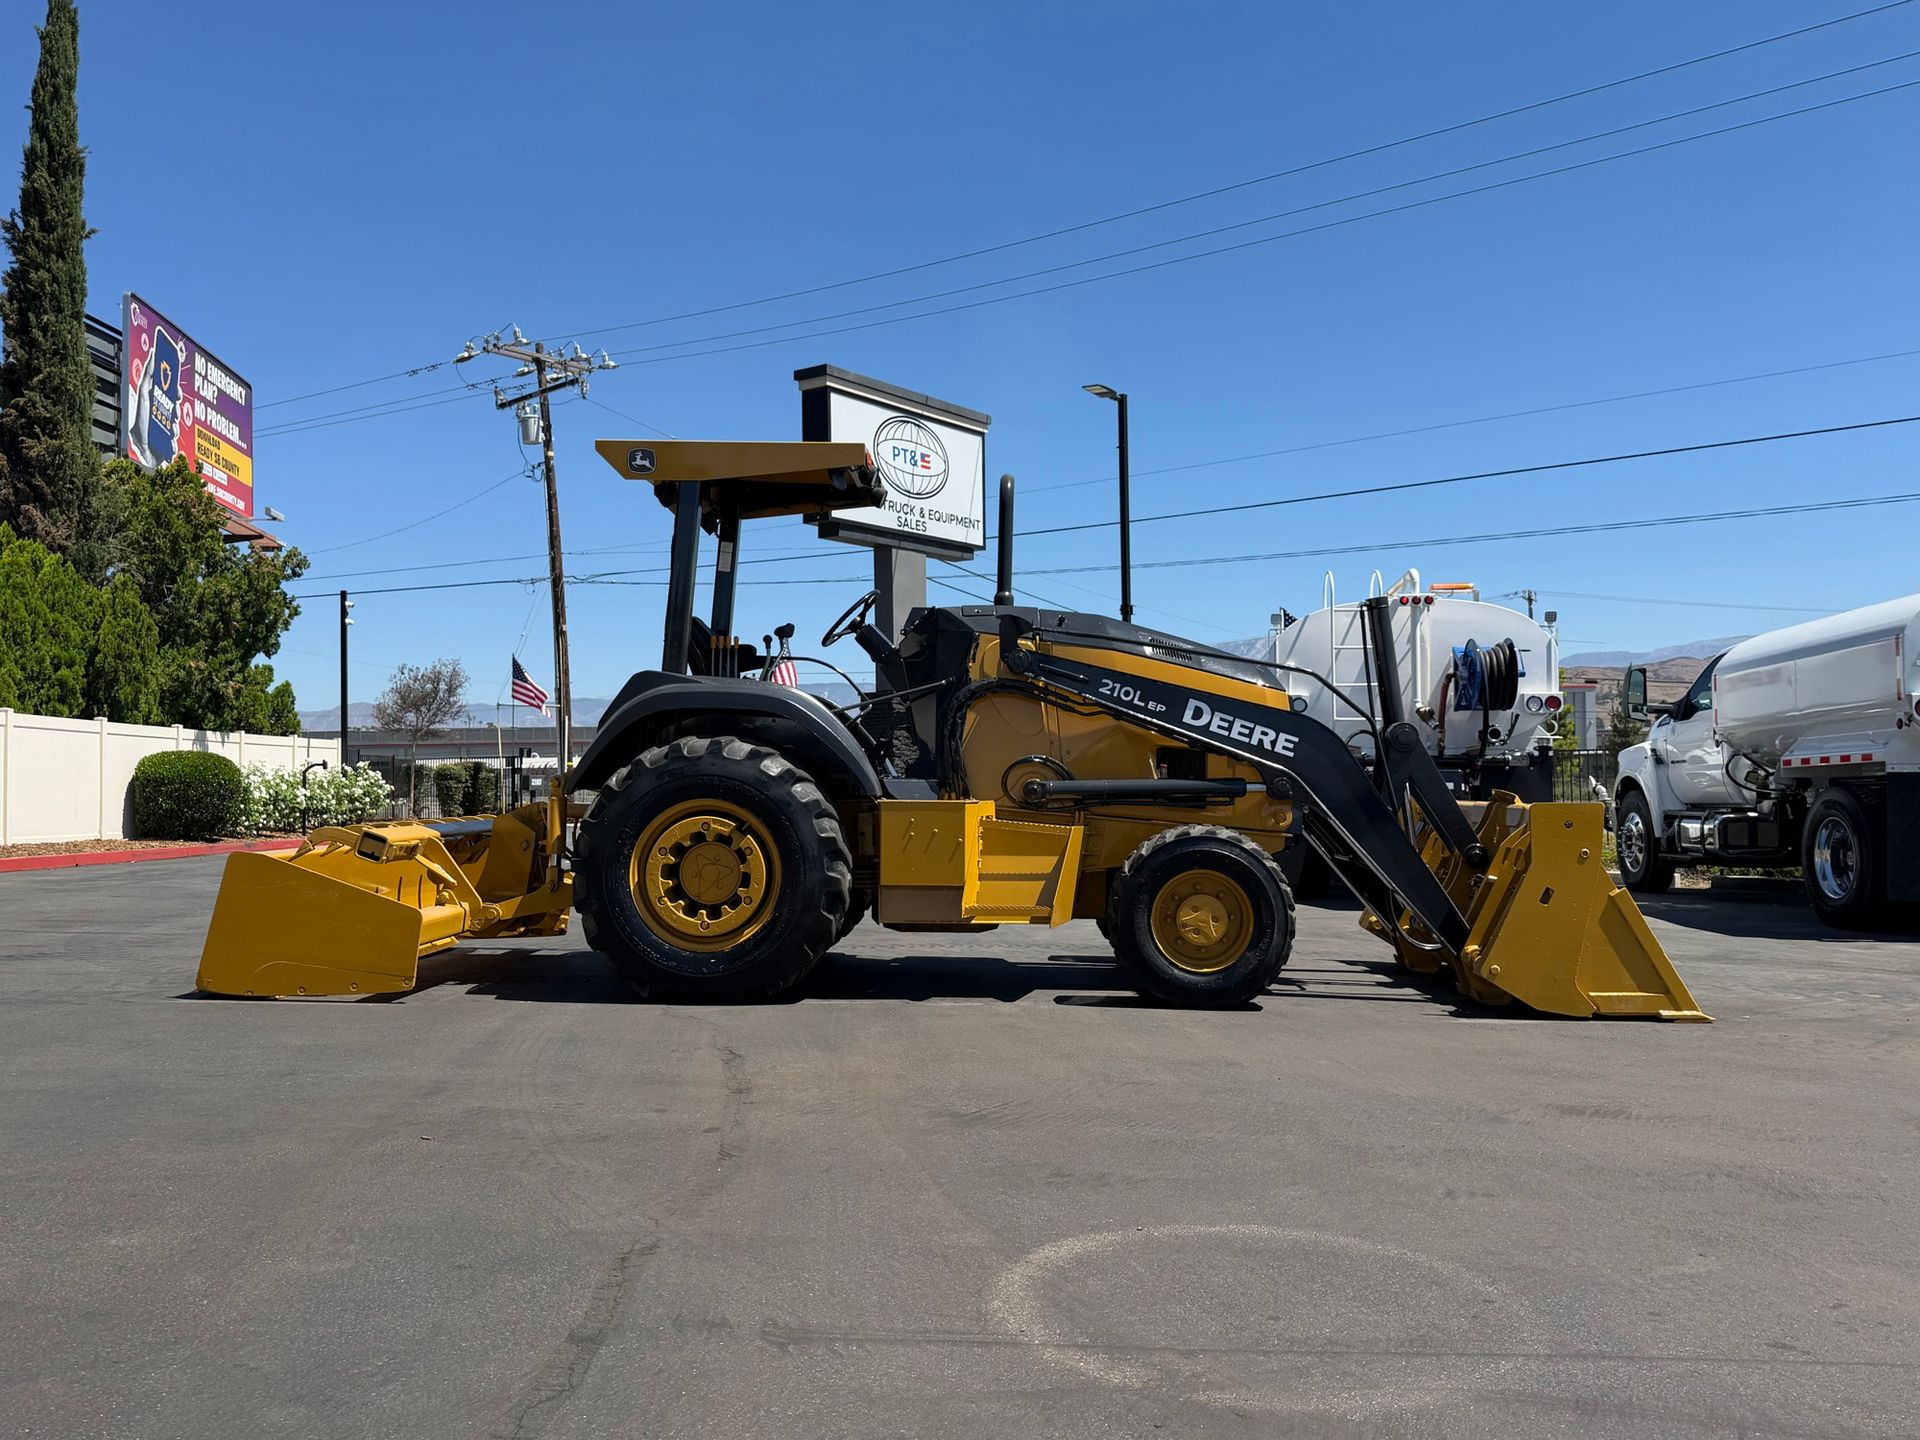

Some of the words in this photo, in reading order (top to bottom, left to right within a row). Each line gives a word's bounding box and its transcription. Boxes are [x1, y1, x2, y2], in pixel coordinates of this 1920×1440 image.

[194, 351, 206, 377] NO
[207, 361, 246, 406] EMERGENCY
[194, 372, 218, 405] PLAN?
[194, 398, 206, 422] NO
[197, 427, 220, 451] DOWNLOAD
[197, 441, 213, 461] READY
[214, 452, 221, 466] SB
[221, 456, 240, 477] COUNTY
[884, 500, 916, 517] TRUCK
[919, 507, 926, 519] &
[928, 509, 981, 530] EQUIPMENT
[896, 515, 928, 533] SALES
[1098, 678, 1146, 708] 210L
[1147, 700, 1167, 713] EP
[1181, 697, 1300, 758] DEERE
